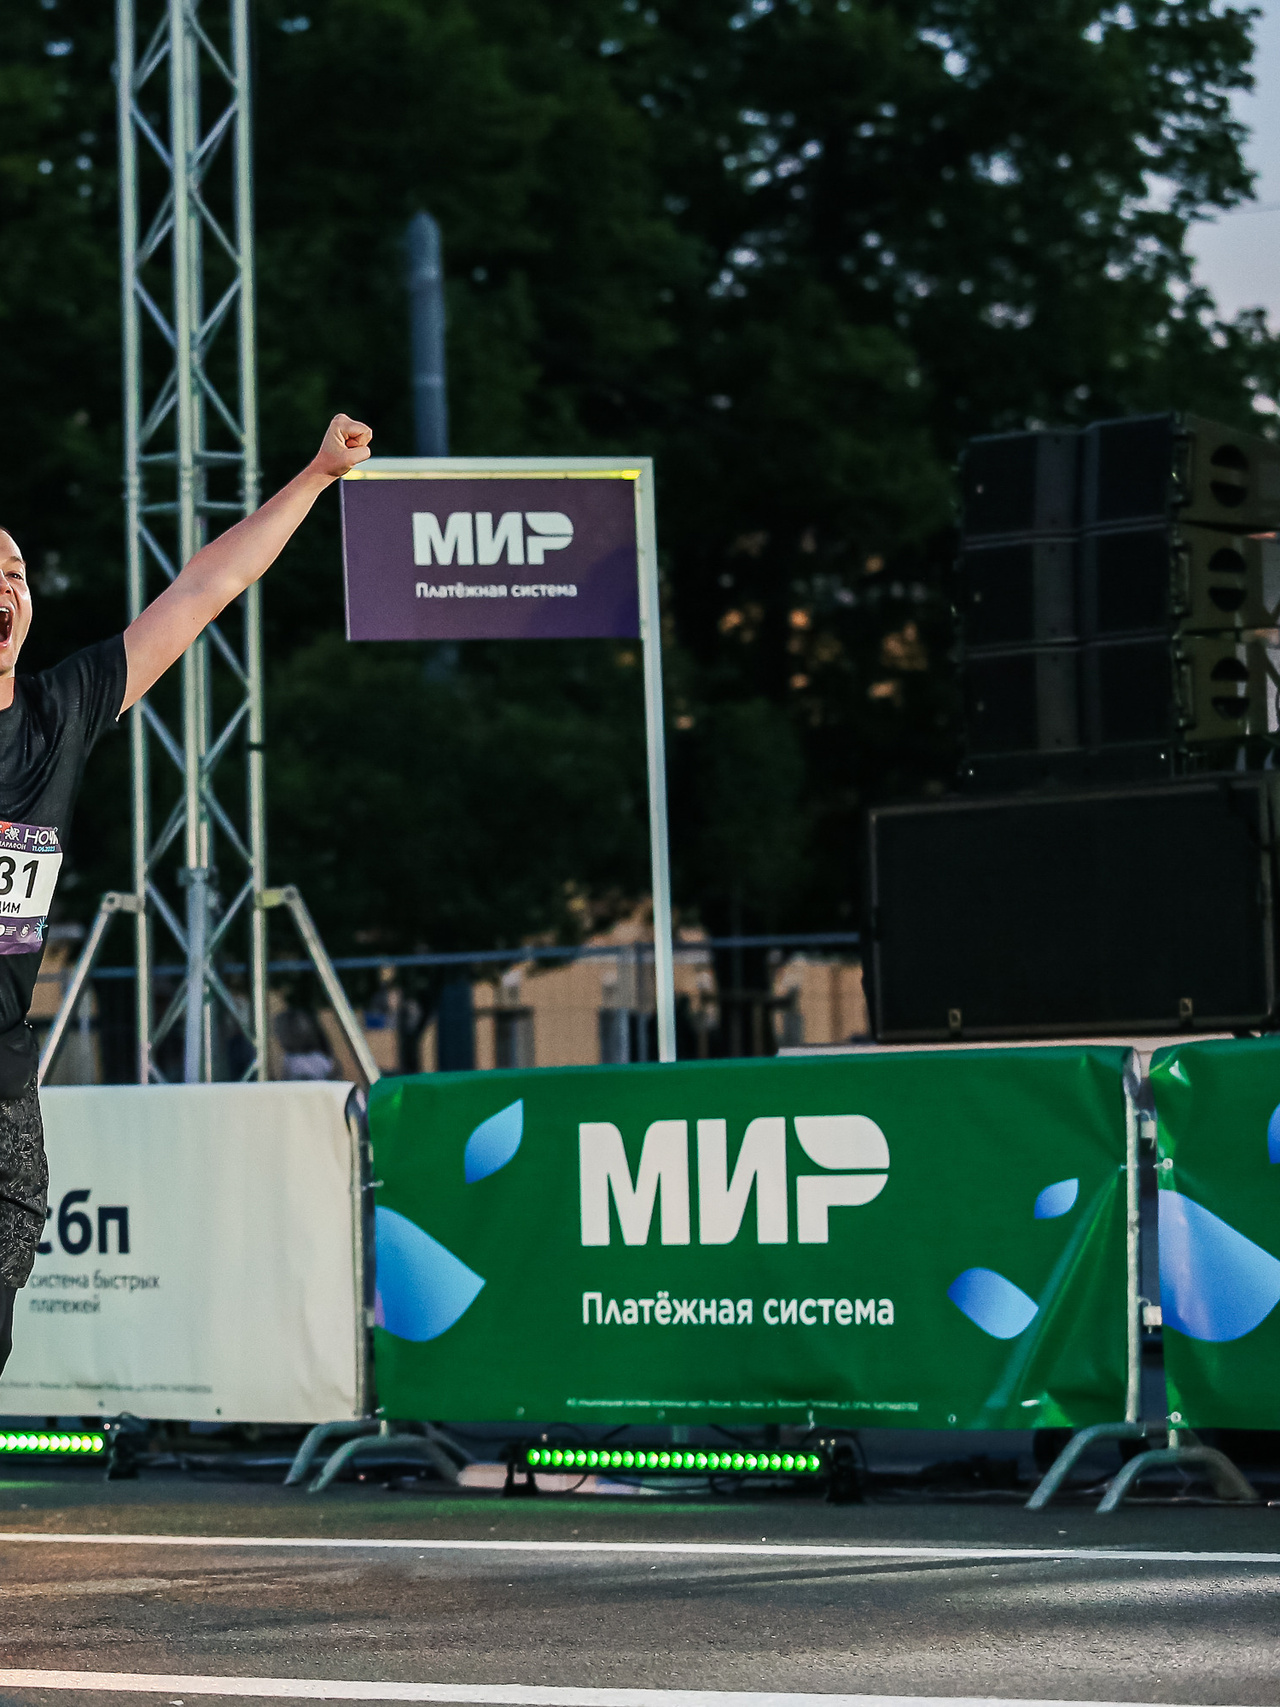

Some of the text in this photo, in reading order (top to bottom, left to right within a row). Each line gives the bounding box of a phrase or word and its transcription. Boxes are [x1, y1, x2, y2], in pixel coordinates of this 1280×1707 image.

[412, 511, 574, 566] МИР
[415, 582, 577, 598] Платёжная система
[579, 1114, 890, 1246] МИР
[582, 1291, 894, 1325] Платёжная система
